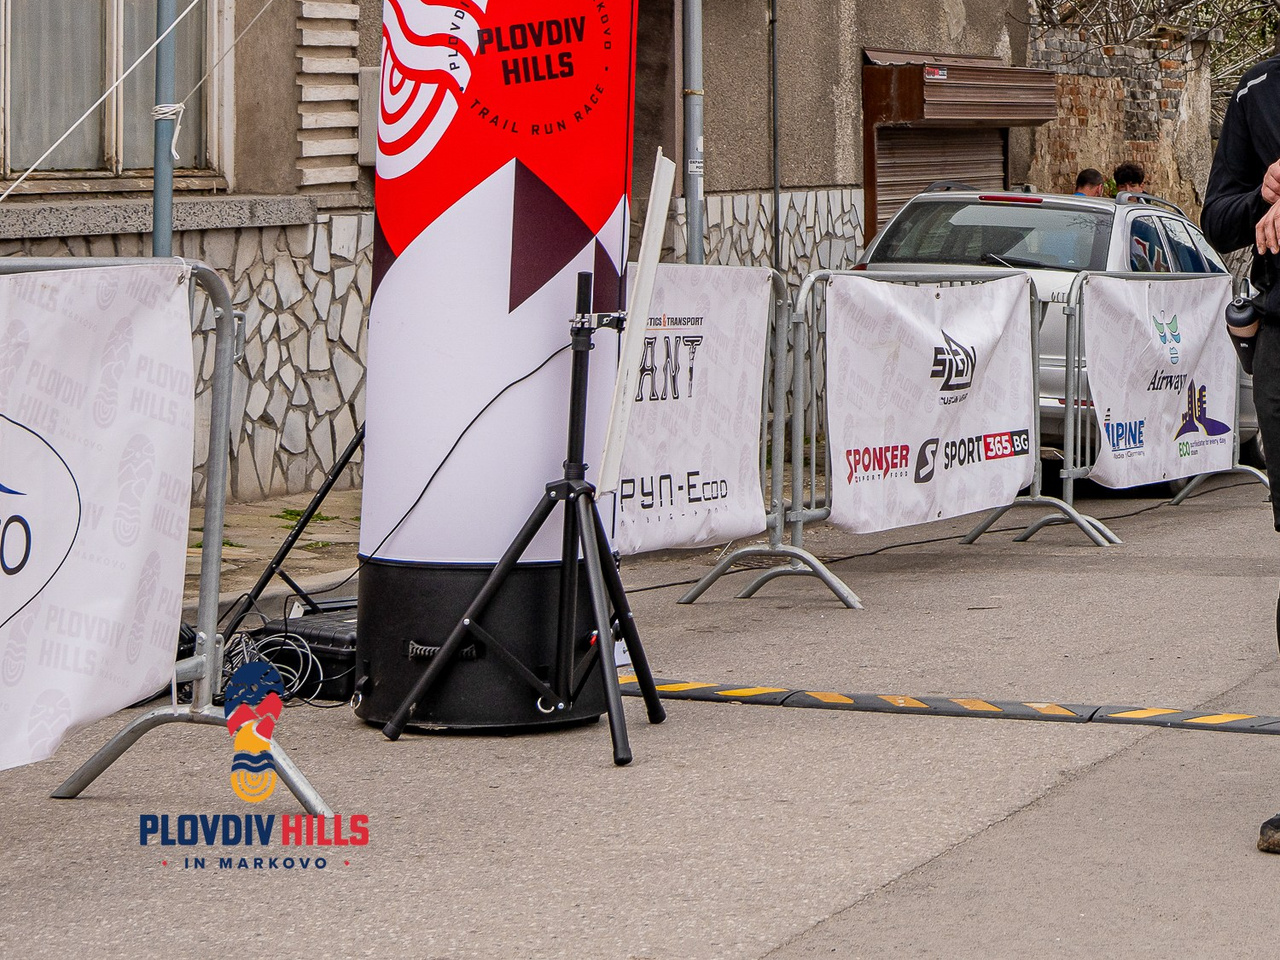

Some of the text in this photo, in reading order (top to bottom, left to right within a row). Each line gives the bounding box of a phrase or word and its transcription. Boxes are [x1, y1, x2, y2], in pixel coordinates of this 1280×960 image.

[477, 15, 586, 55] PLOVDIV
[501, 51, 575, 86] HILLS
[470, 83, 604, 136] TRAIL RUN RACE
[667, 316, 704, 326] TRANSPORT
[845, 444, 910, 486] SPONSER
